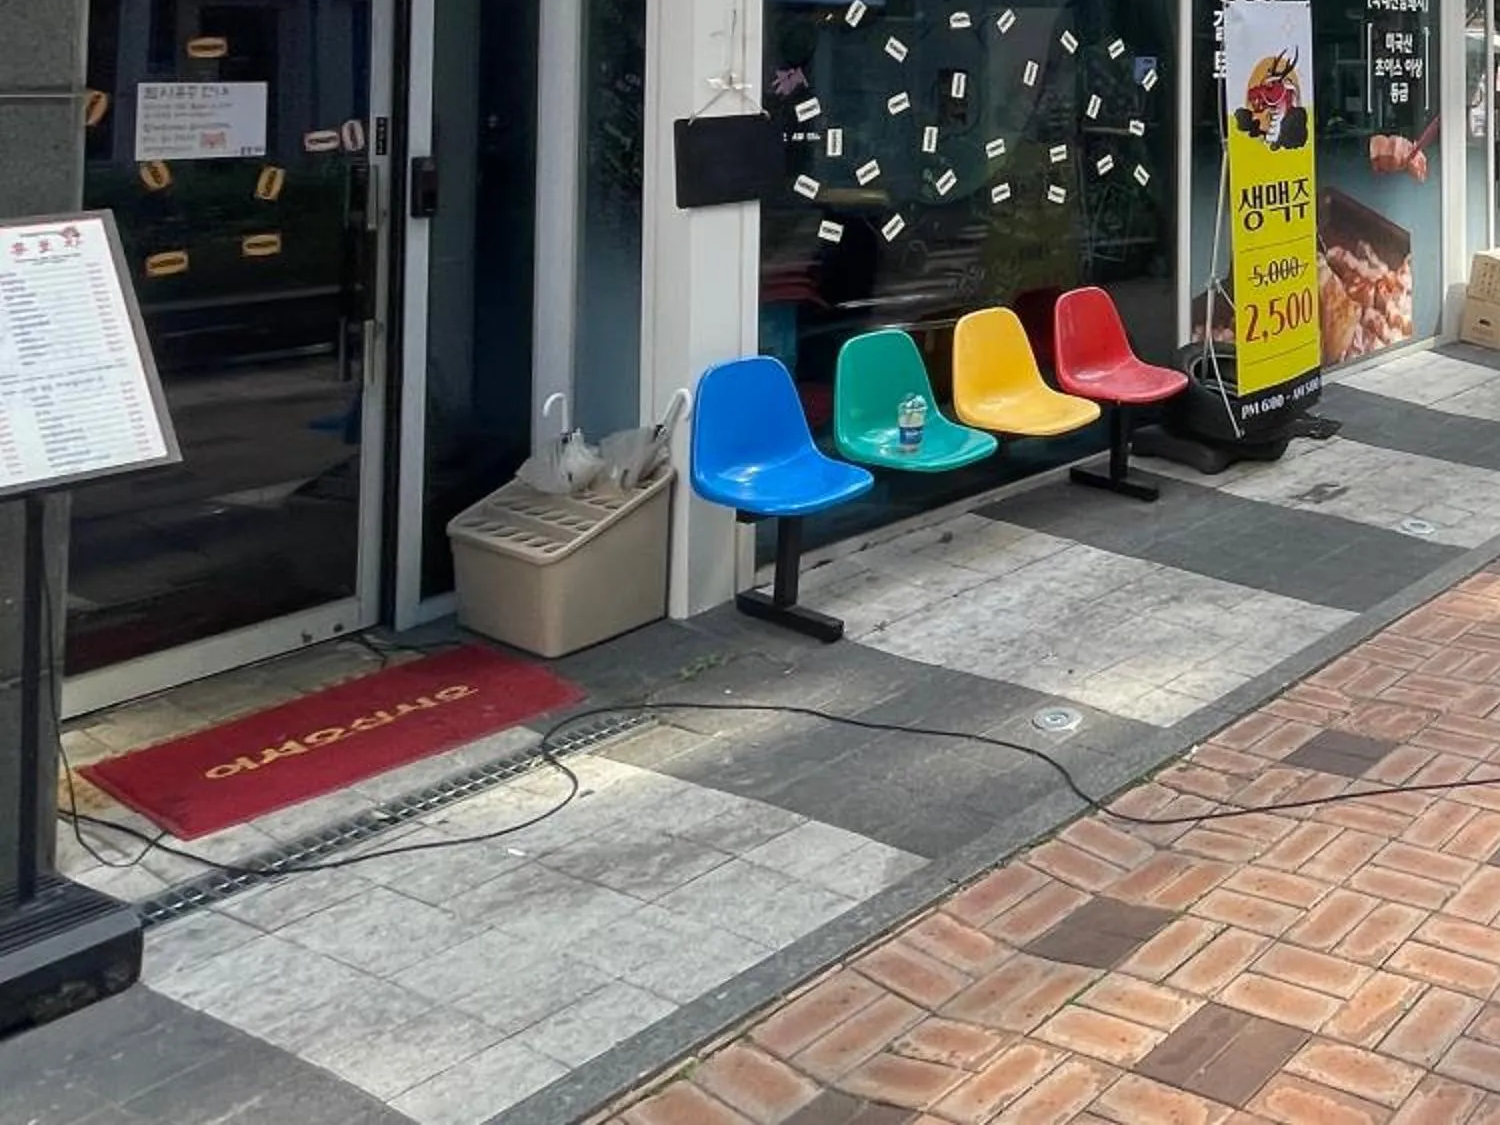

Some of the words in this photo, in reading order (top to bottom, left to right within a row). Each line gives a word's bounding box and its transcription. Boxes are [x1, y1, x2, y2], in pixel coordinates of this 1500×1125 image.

[1385, 32, 1413, 53] 미국산
[1375, 58, 1403, 78] 초이스
[1391, 82, 1409, 104] 등급
[1238, 178, 1309, 232] 생맥주
[1252, 256, 1300, 289] 5,000
[1244, 287, 1313, 343] 2,500
[1241, 401, 1259, 420] PM
